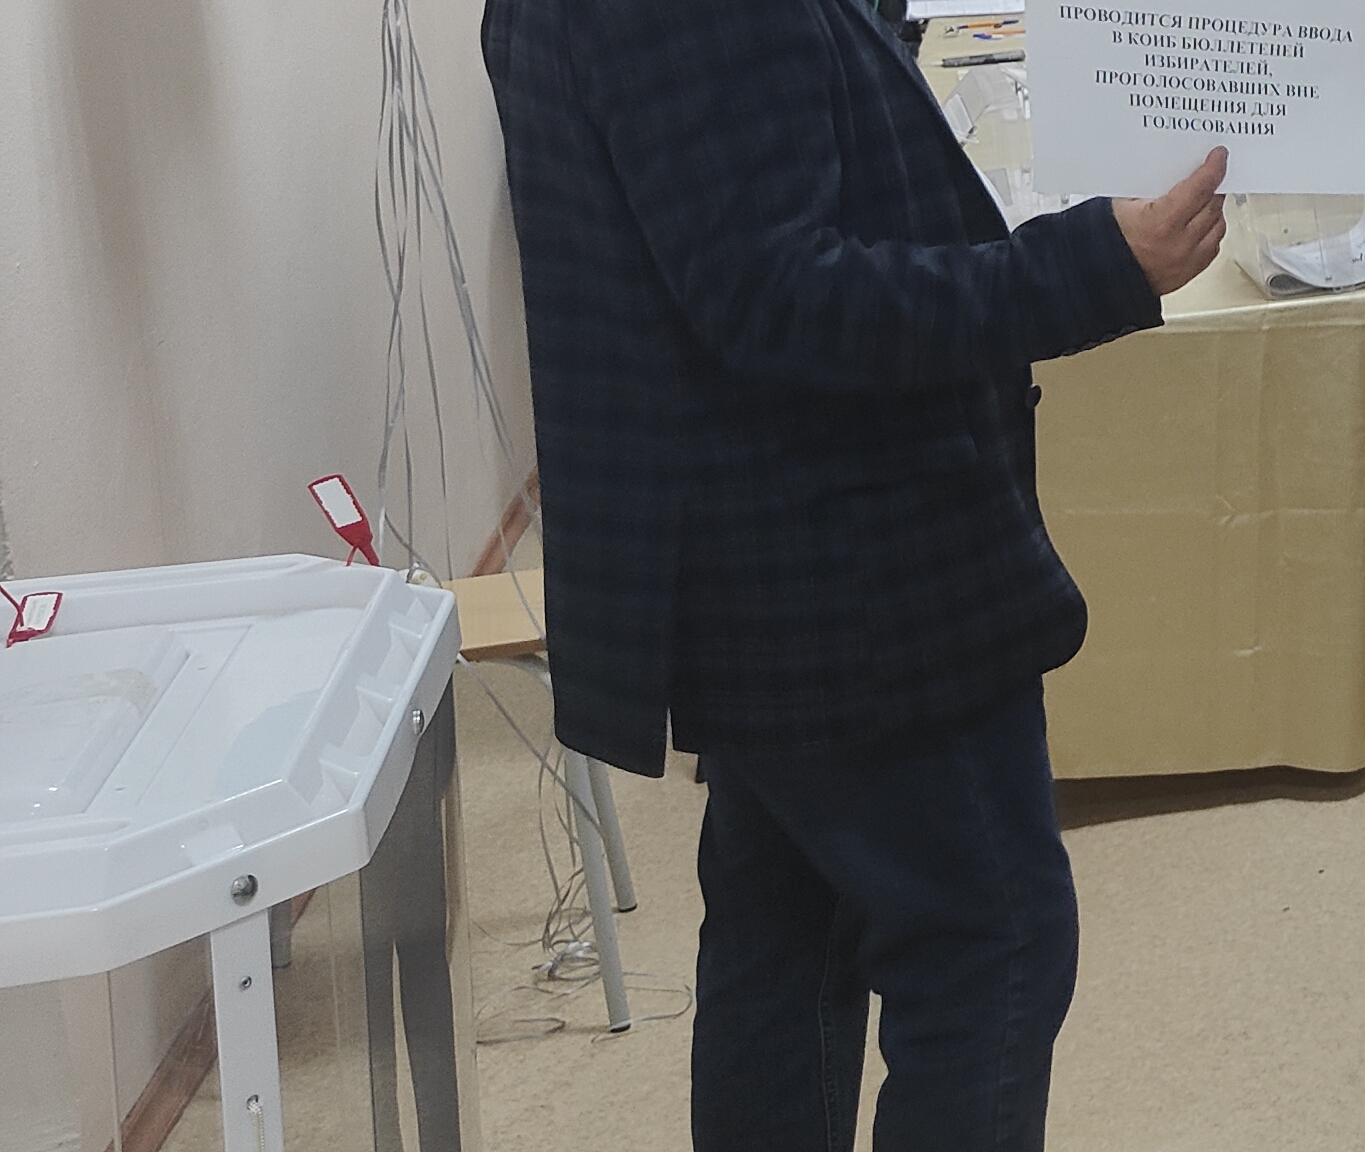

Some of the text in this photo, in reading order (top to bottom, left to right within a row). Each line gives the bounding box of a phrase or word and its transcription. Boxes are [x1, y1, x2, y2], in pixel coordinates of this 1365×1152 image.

[1060, 5, 1353, 43] ПРОВОДИТСЯ ПРОЦЕДУРА ВВОДА
[1112, 30, 1304, 58] В КОИБ БЮЛЛЕТЕНЕЙ
[1145, 53, 1273, 78] ИЗБИРАТЕЛЕЙ,
[1095, 69, 1320, 99] ПРОГОЛОСОВАВШИХ ВНЕ
[1130, 93, 1286, 117] ПОМЕЩЕНИЯ ДЛЯ
[1143, 114, 1274, 136] ГОЛОСОВАНИЯ
